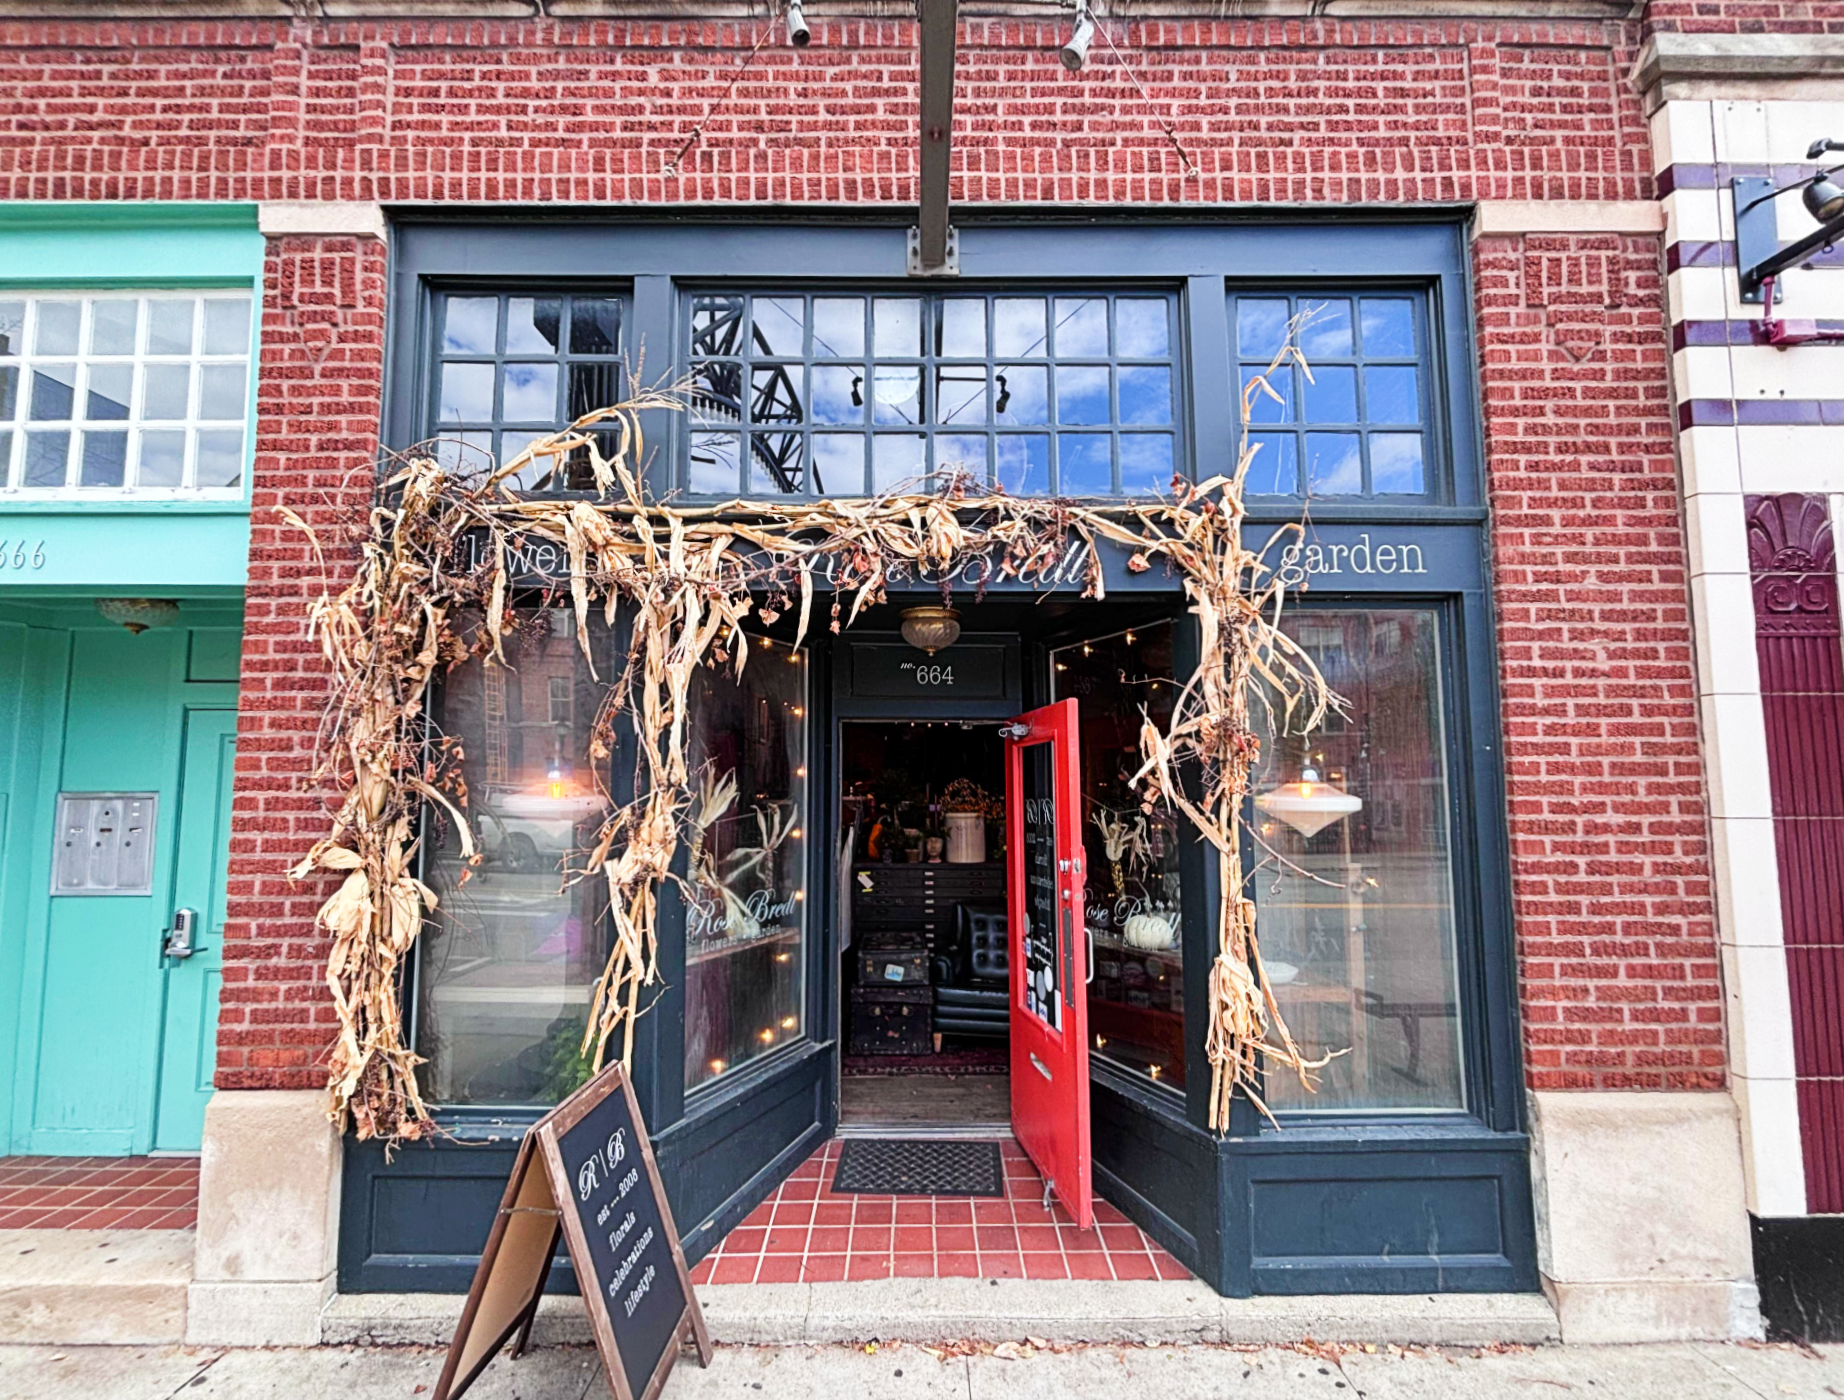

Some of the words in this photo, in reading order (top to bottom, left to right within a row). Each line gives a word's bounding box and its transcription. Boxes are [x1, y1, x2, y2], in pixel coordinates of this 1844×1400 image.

[1280, 533, 1427, 583] garden
[916, 665, 954, 685] 664
[597, 1204, 611, 1226] est
[618, 1168, 640, 1198] 2008
[609, 1211, 636, 1253] florals
[609, 1226, 654, 1297] celebrations
[624, 1264, 656, 1318] lifestyle
